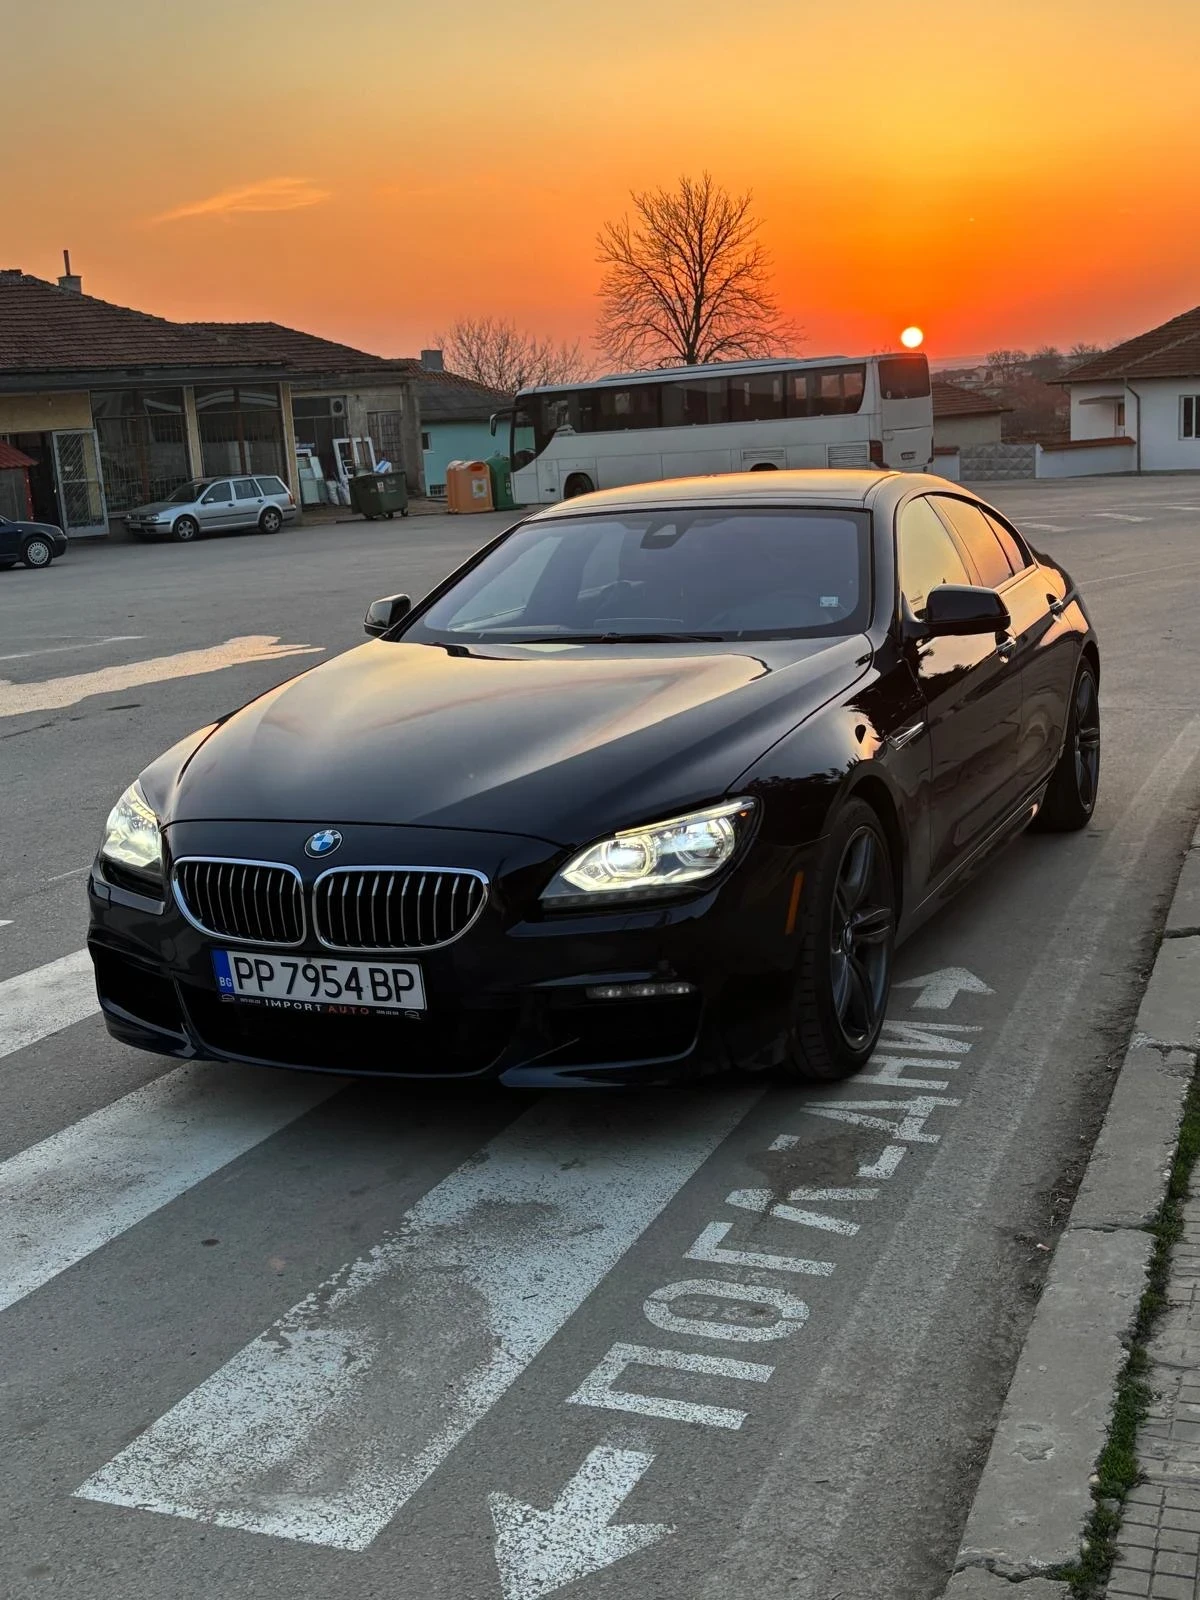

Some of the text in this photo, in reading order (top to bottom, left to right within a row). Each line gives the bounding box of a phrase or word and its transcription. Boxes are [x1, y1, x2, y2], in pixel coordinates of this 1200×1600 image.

[220, 976, 232, 987] BG
[264, 999, 323, 1011] IMPORT
[328, 1005, 369, 1015] AUTO
